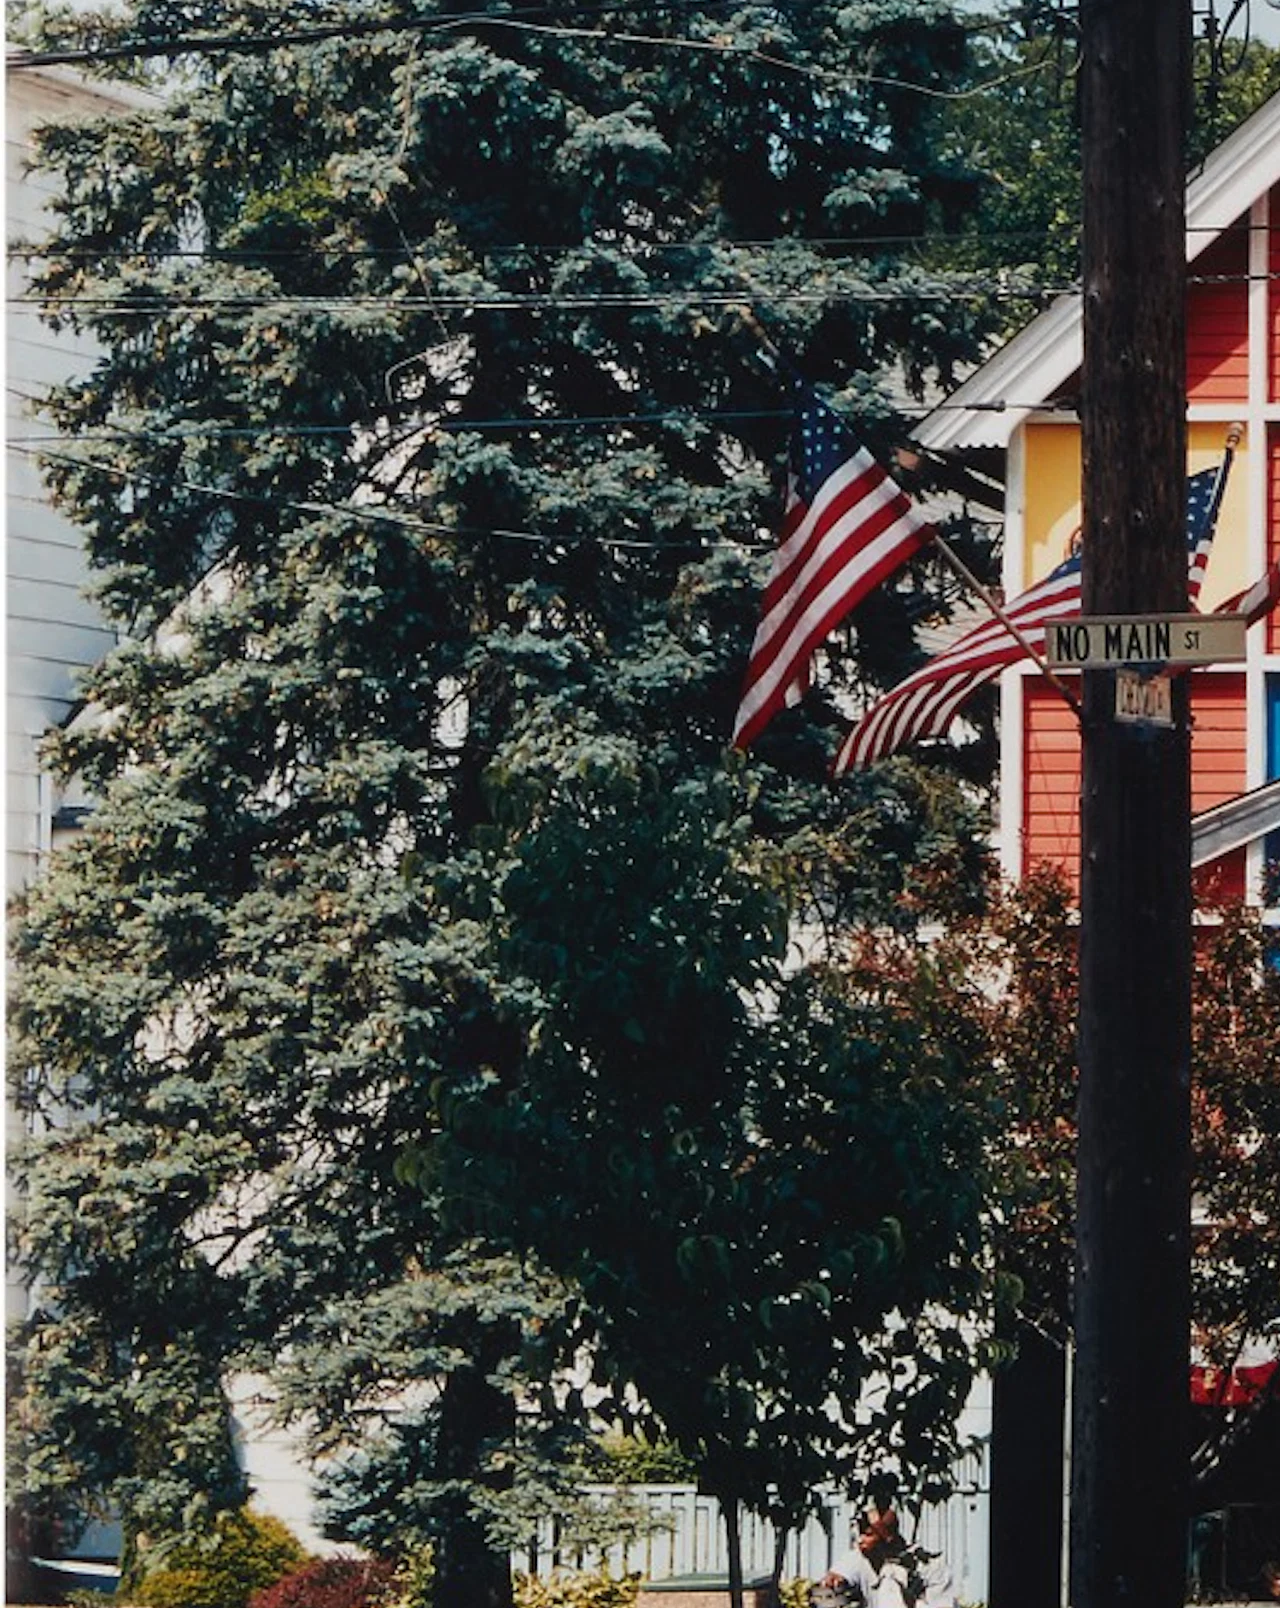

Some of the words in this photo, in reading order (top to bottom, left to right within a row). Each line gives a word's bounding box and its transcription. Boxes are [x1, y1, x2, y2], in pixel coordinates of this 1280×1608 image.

[1057, 625, 1090, 661] NO
[1105, 622, 1170, 659] MAIN
[1184, 630, 1200, 650] ST
